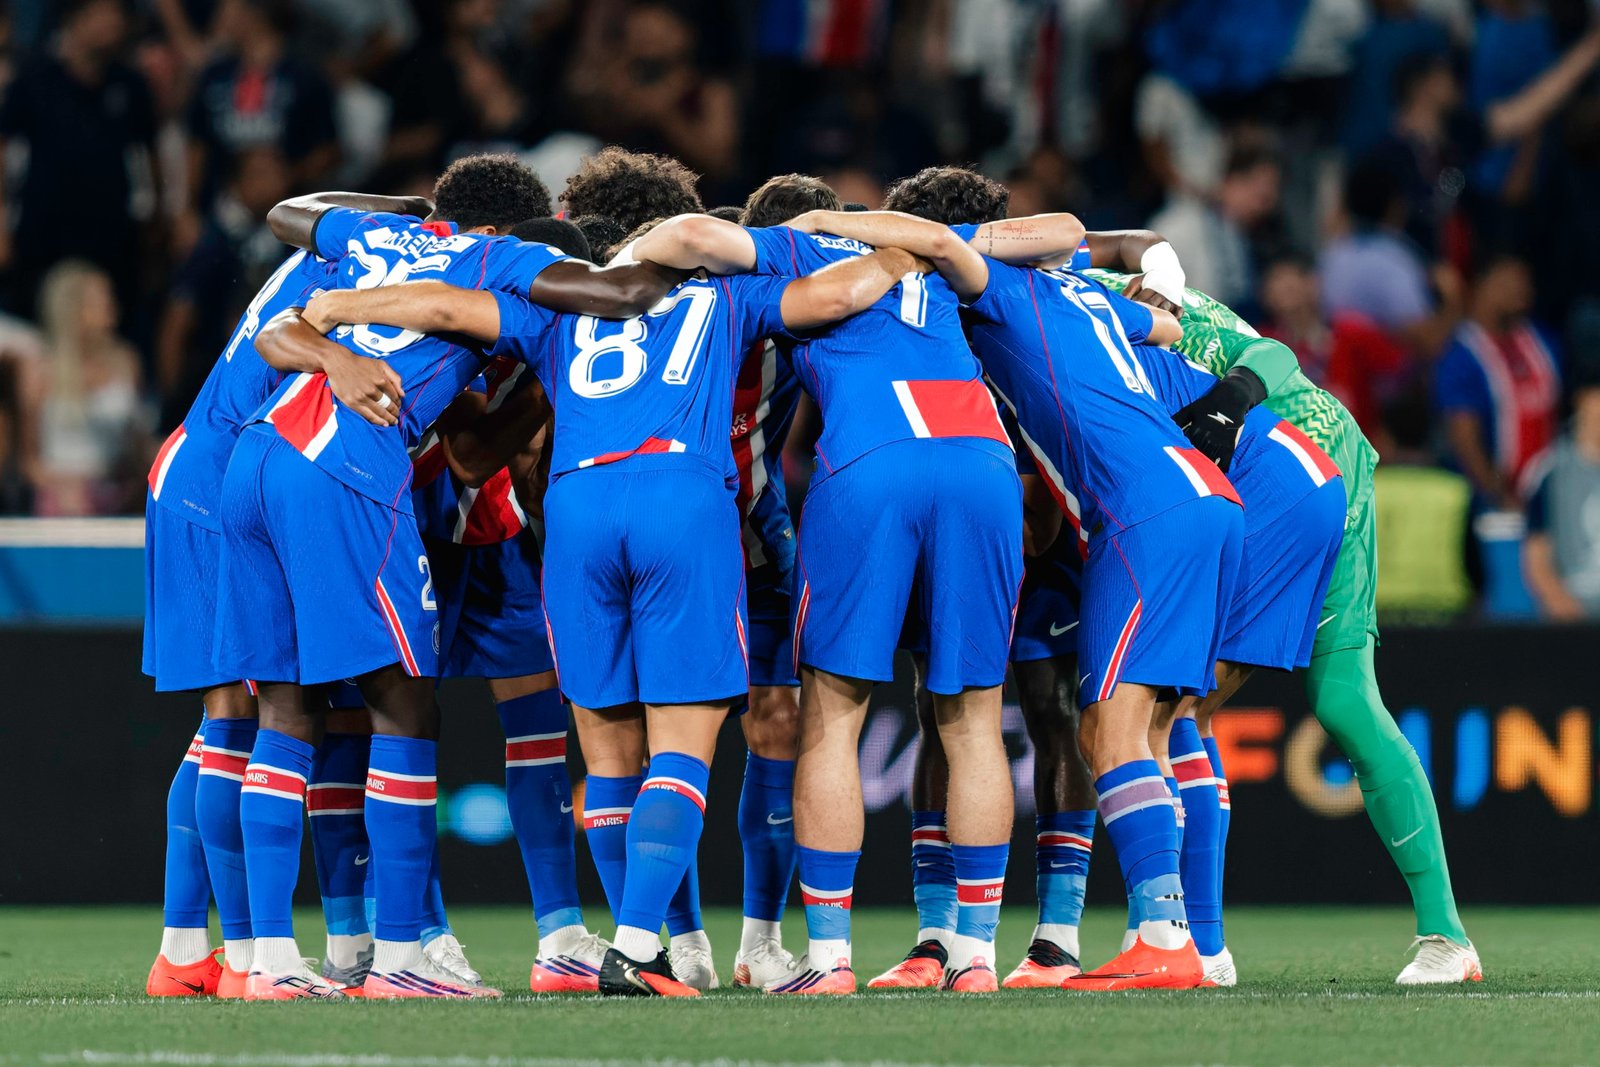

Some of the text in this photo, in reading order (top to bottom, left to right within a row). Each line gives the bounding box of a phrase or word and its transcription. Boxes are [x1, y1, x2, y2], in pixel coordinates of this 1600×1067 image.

[569, 286, 717, 399] 87
[246, 772, 269, 784] PARIS
[593, 816, 623, 828] PARIS
